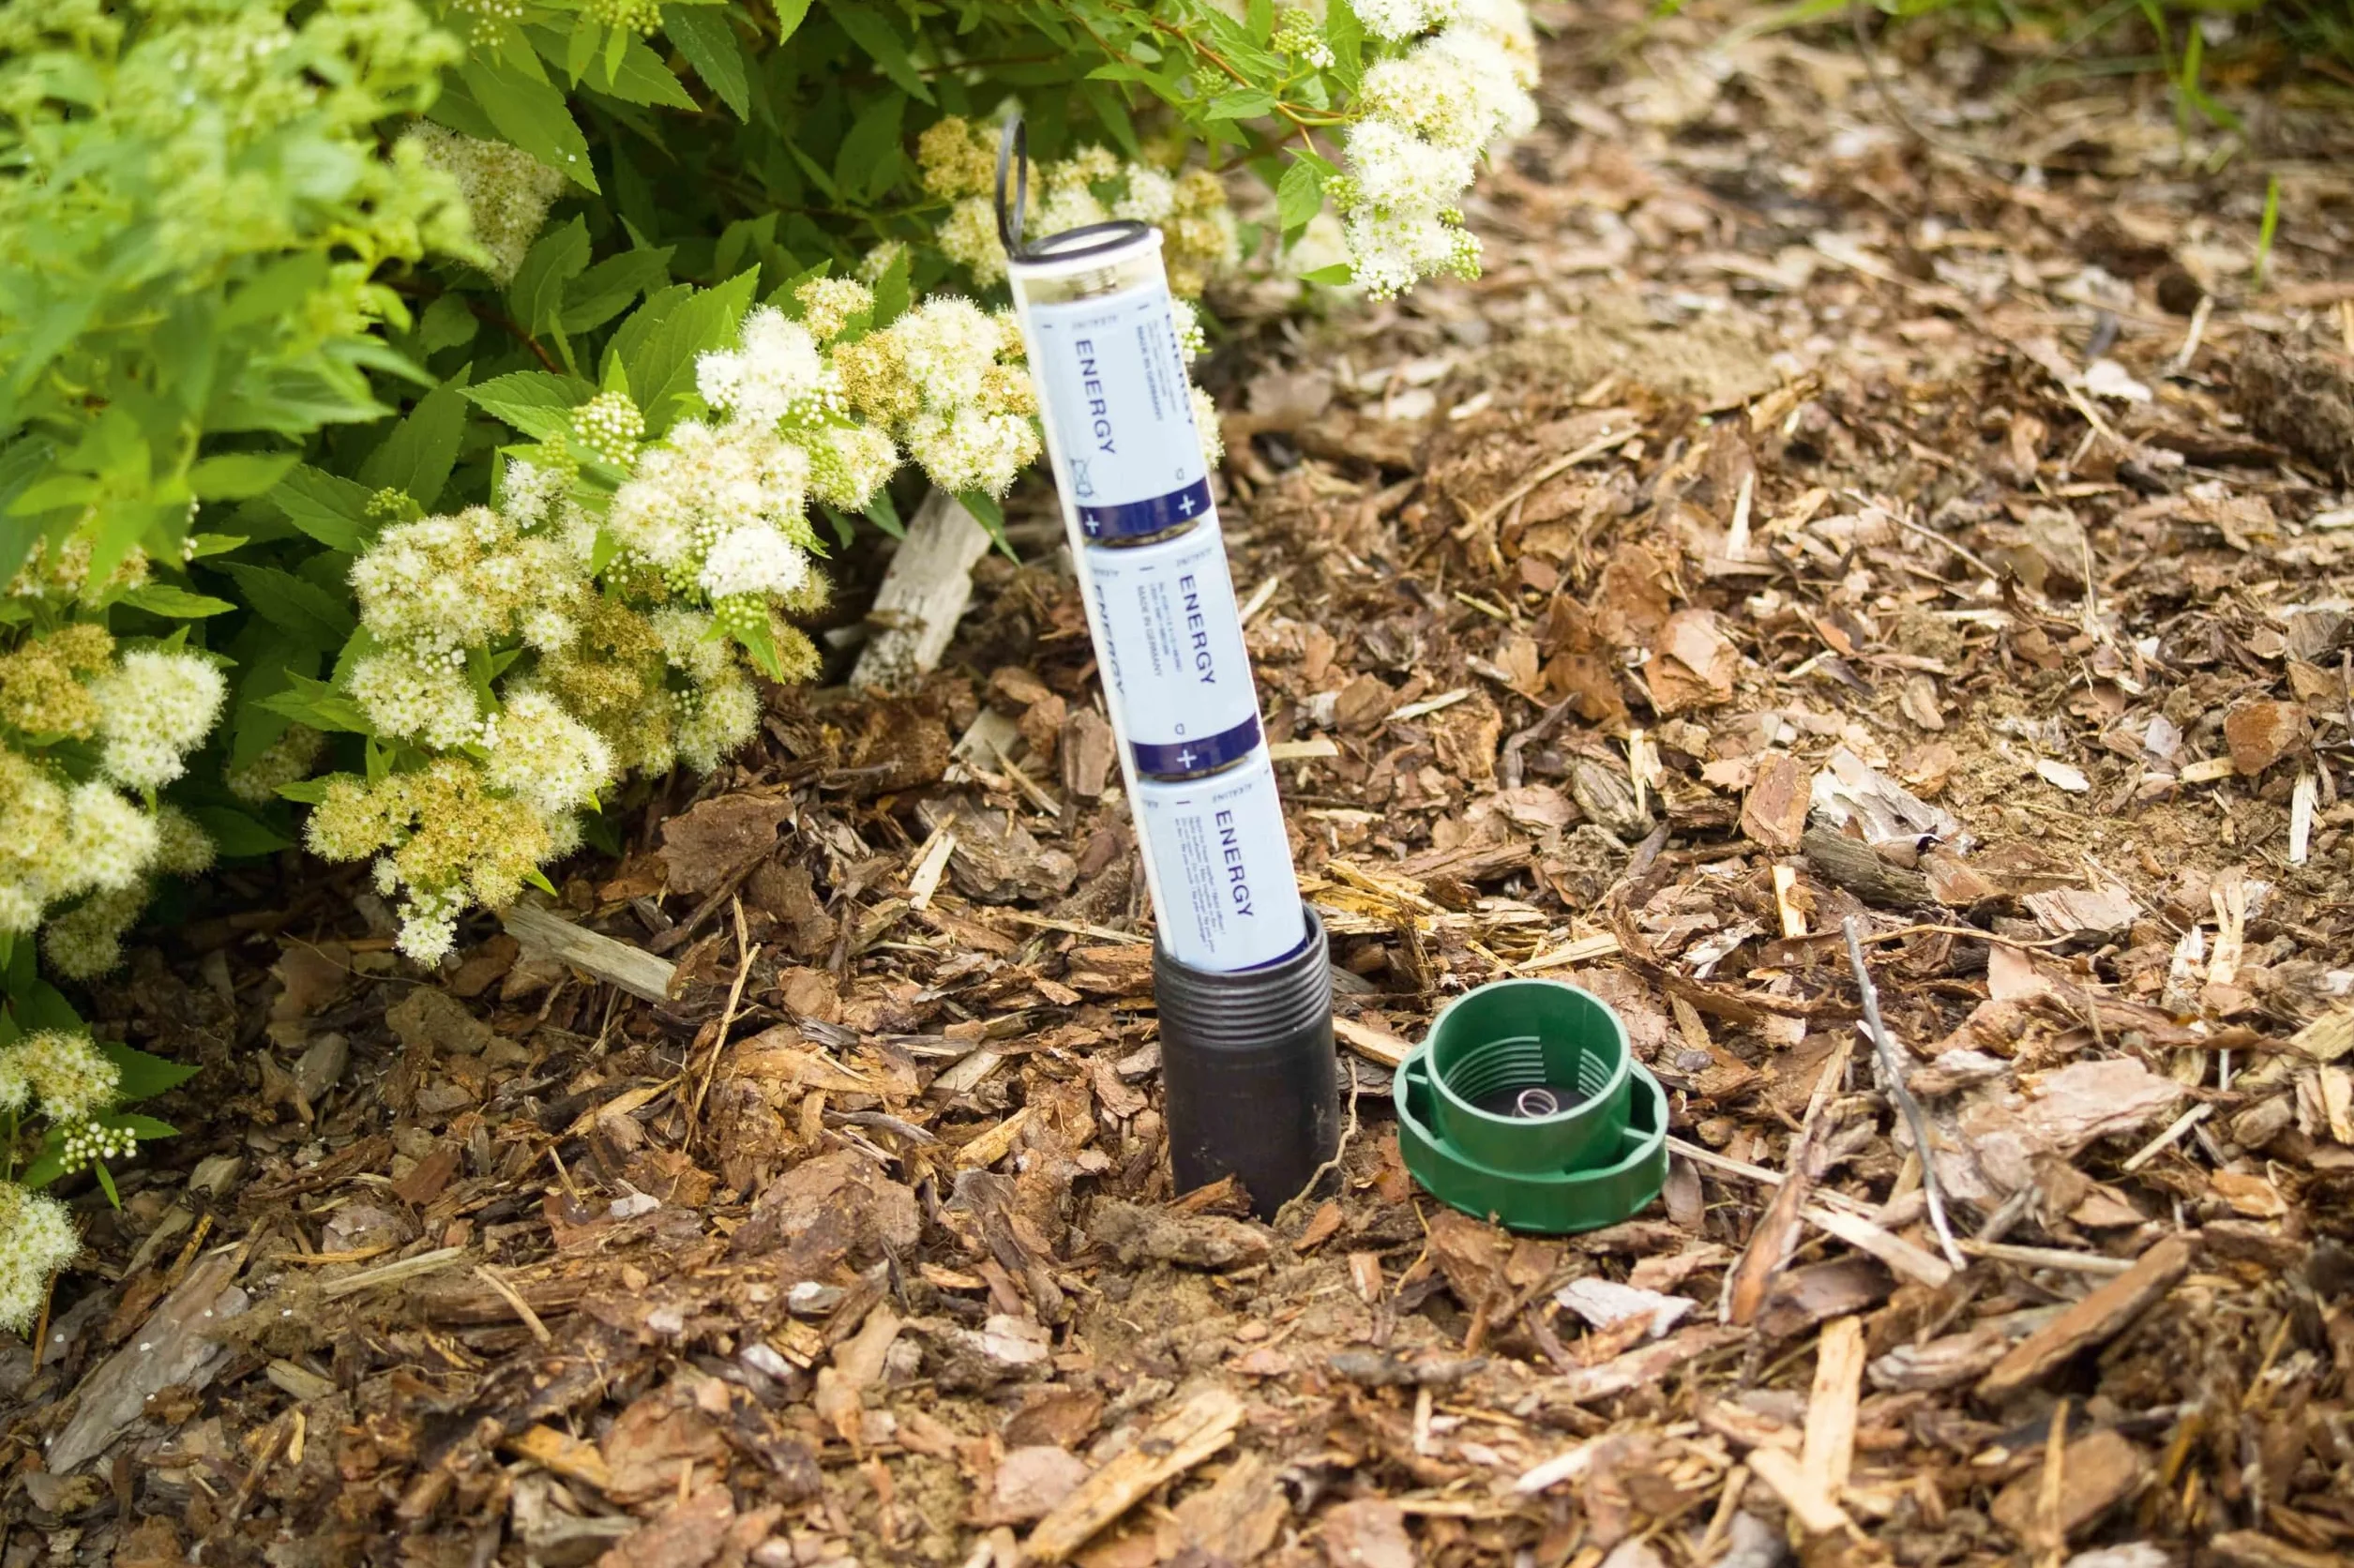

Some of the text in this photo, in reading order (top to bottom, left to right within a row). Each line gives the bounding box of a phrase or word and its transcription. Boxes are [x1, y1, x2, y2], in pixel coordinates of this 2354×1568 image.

[1075, 339, 1116, 455] ENERGY
[1179, 574, 1216, 685] ENERGY
[1215, 809, 1255, 918] ENERGY
